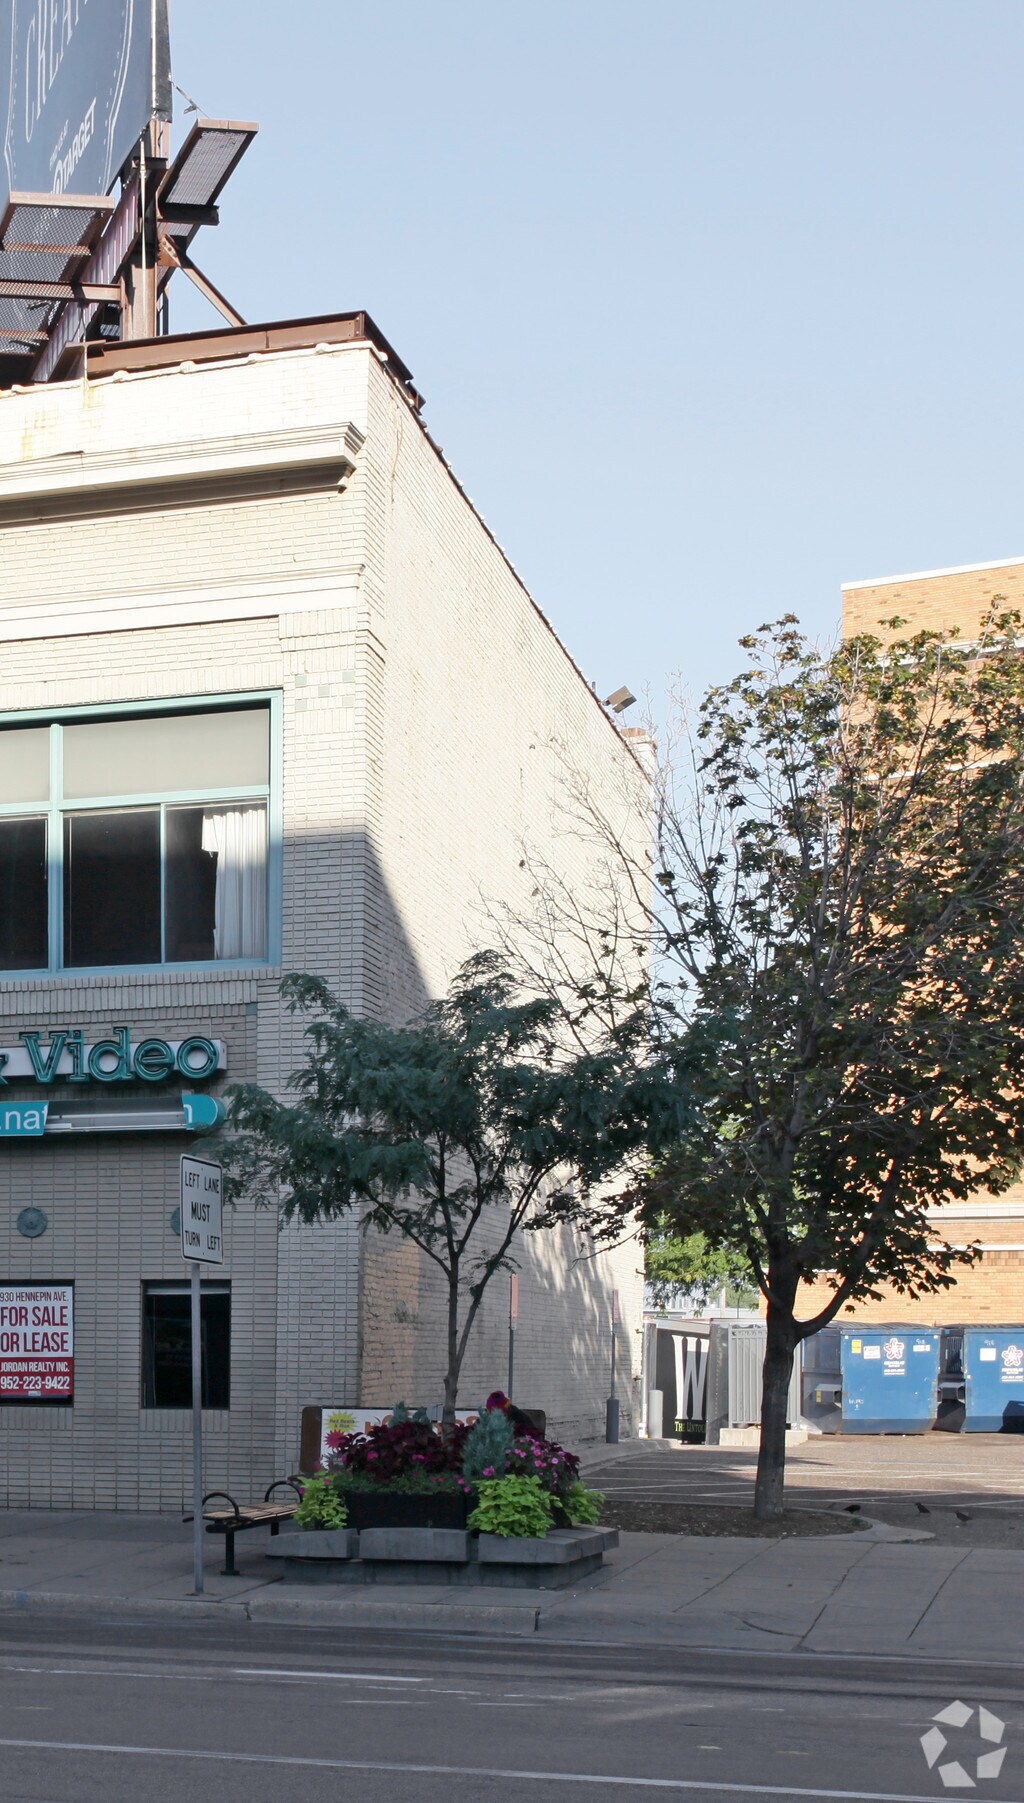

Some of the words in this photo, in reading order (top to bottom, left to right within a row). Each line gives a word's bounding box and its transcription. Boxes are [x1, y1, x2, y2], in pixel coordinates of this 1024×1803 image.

[63, 97, 96, 190] TARGET
[19, 1026, 220, 1083] Video
[185, 1171, 200, 1189] LEFT
[204, 1176, 220, 1194] LANE
[191, 1201, 210, 1222] MUST
[185, 1230, 201, 1247] TURN
[206, 1234, 220, 1251] LEFT
[0, 1292, 14, 1302] 930
[16, 1292, 52, 1302] HENNEPIN
[53, 1291, 68, 1301] AVE.
[0, 1307, 28, 1326] FOR
[32, 1306, 68, 1326] SALE
[0, 1332, 20, 1352] OR
[24, 1332, 69, 1352] LEASE
[0, 1362, 27, 1372] JORDAN
[29, 1362, 55, 1372] REALTY
[56, 1362, 70, 1372] INC.
[0, 1376, 70, 1390] 952-223-9422
